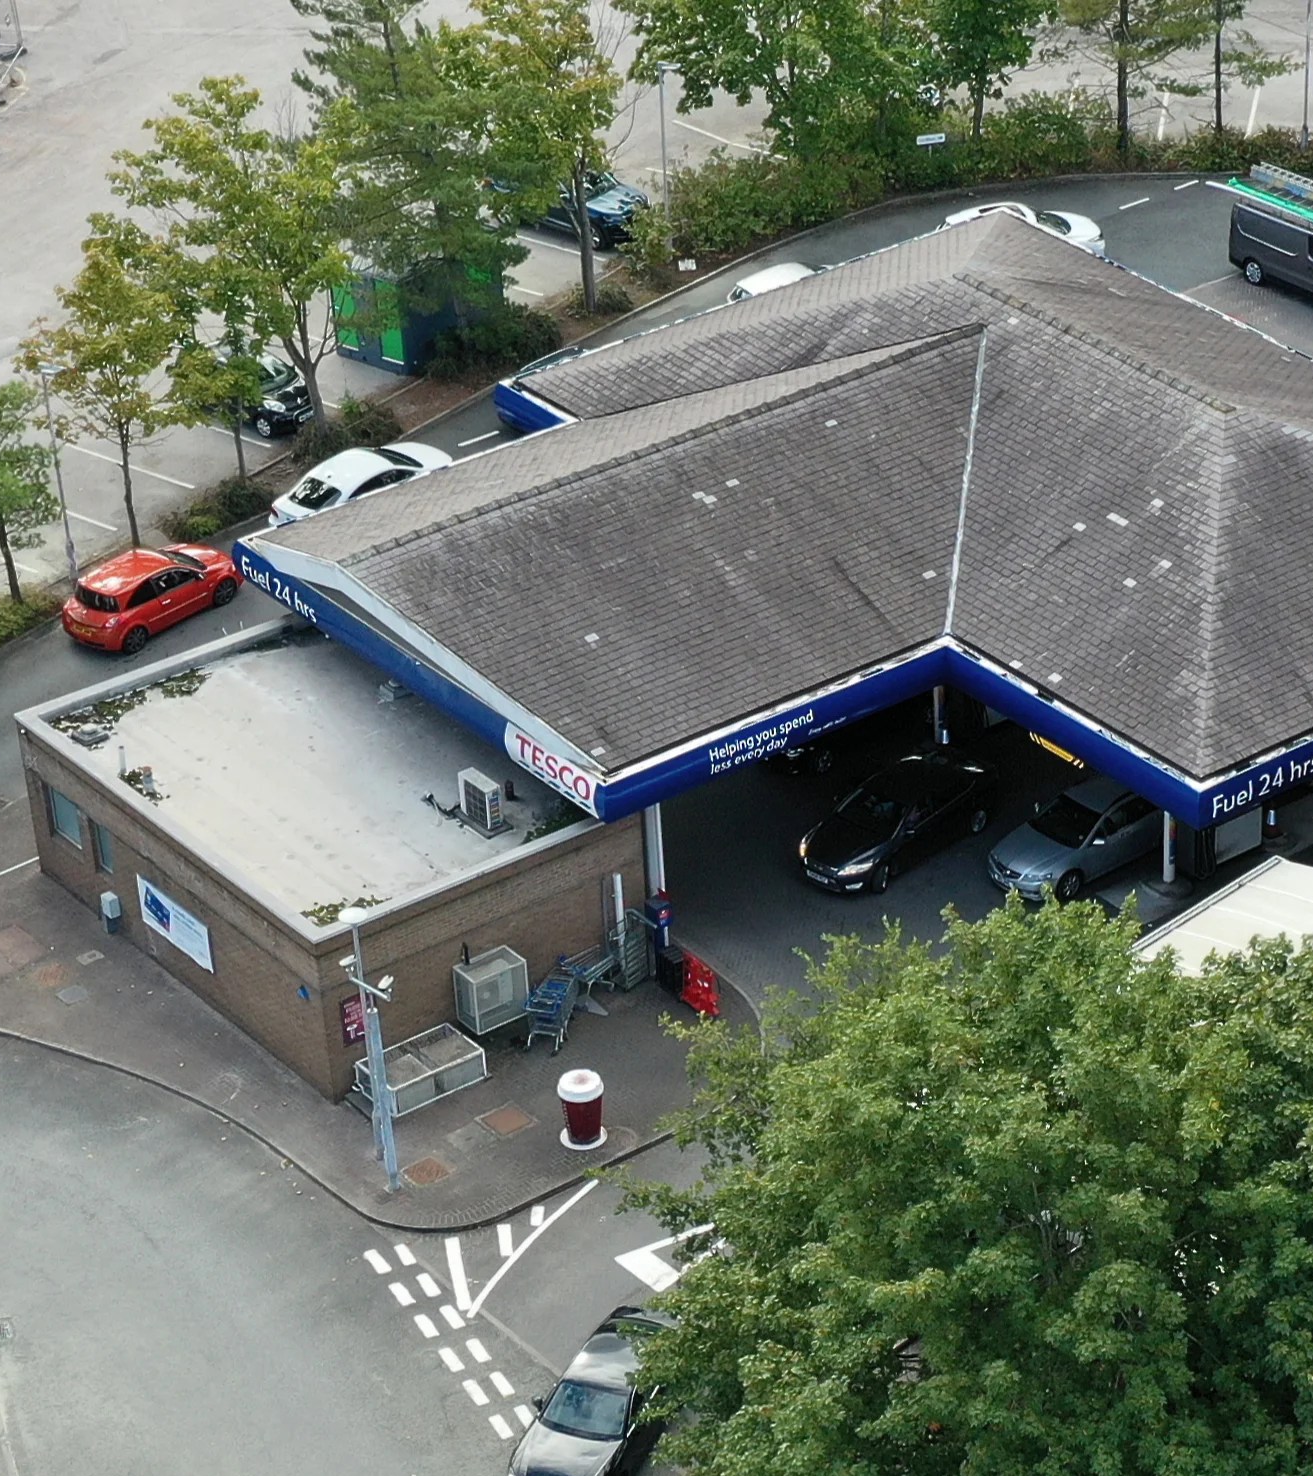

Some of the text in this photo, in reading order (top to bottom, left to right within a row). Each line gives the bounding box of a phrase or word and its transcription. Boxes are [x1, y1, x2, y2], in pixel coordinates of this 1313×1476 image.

[241, 555, 317, 623] Fuel 24 hrs
[709, 737, 755, 763] Helping
[756, 727, 778, 747] you
[779, 708, 814, 735] spend
[710, 736, 788, 775] less every day
[515, 733, 591, 801] TESCO
[1212, 780, 1253, 819] Fuel
[1258, 766, 1284, 797] 24
